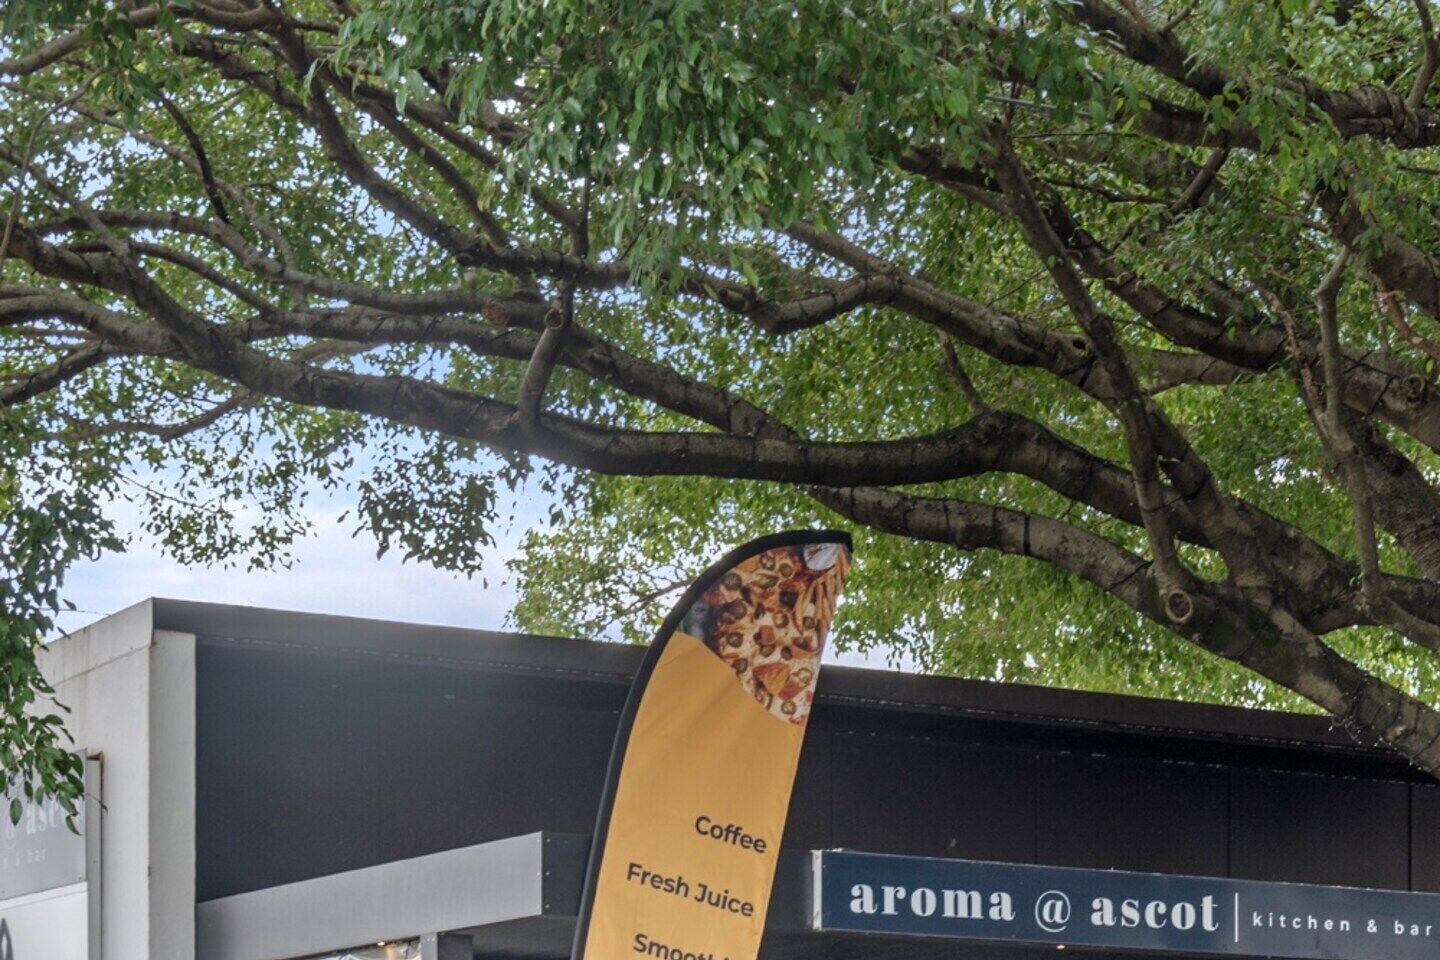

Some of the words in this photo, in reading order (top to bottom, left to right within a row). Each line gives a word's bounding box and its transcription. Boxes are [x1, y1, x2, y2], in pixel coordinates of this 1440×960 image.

[694, 815, 767, 854] Coffee
[626, 862, 690, 899] Fresh
[694, 883, 754, 917] Juice
[850, 883, 955, 922] aroma
[1034, 889, 1071, 933] @
[1090, 895, 1219, 932] ascot
[1252, 911, 1350, 932] kitchen
[1366, 919, 1378, 933] &
[1394, 920, 1433, 937] bar
